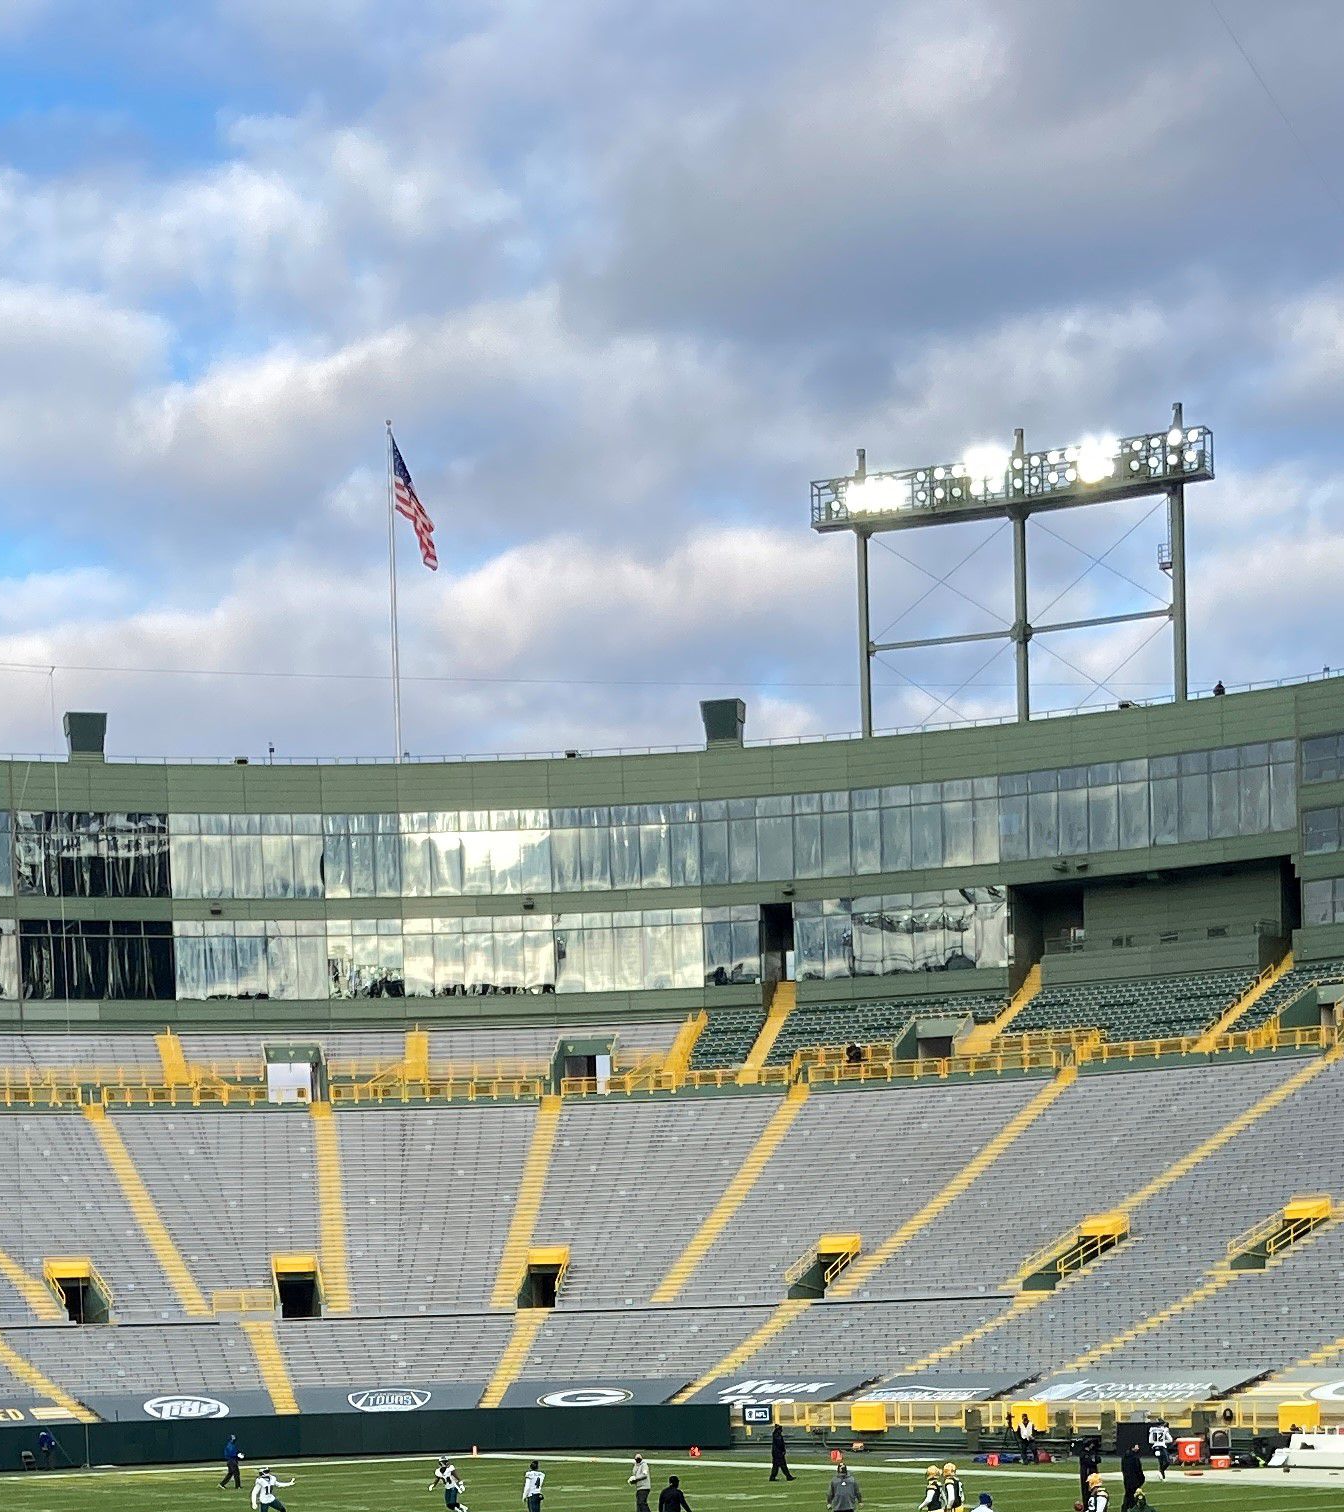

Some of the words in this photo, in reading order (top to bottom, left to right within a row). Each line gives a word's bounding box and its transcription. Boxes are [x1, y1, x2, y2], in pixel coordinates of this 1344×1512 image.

[1093, 1382, 1213, 1391] CONCORDIA
[368, 1394, 412, 1407] TOURS
[156, 1400, 217, 1418] Tide
[1184, 1444, 1197, 1456] G
